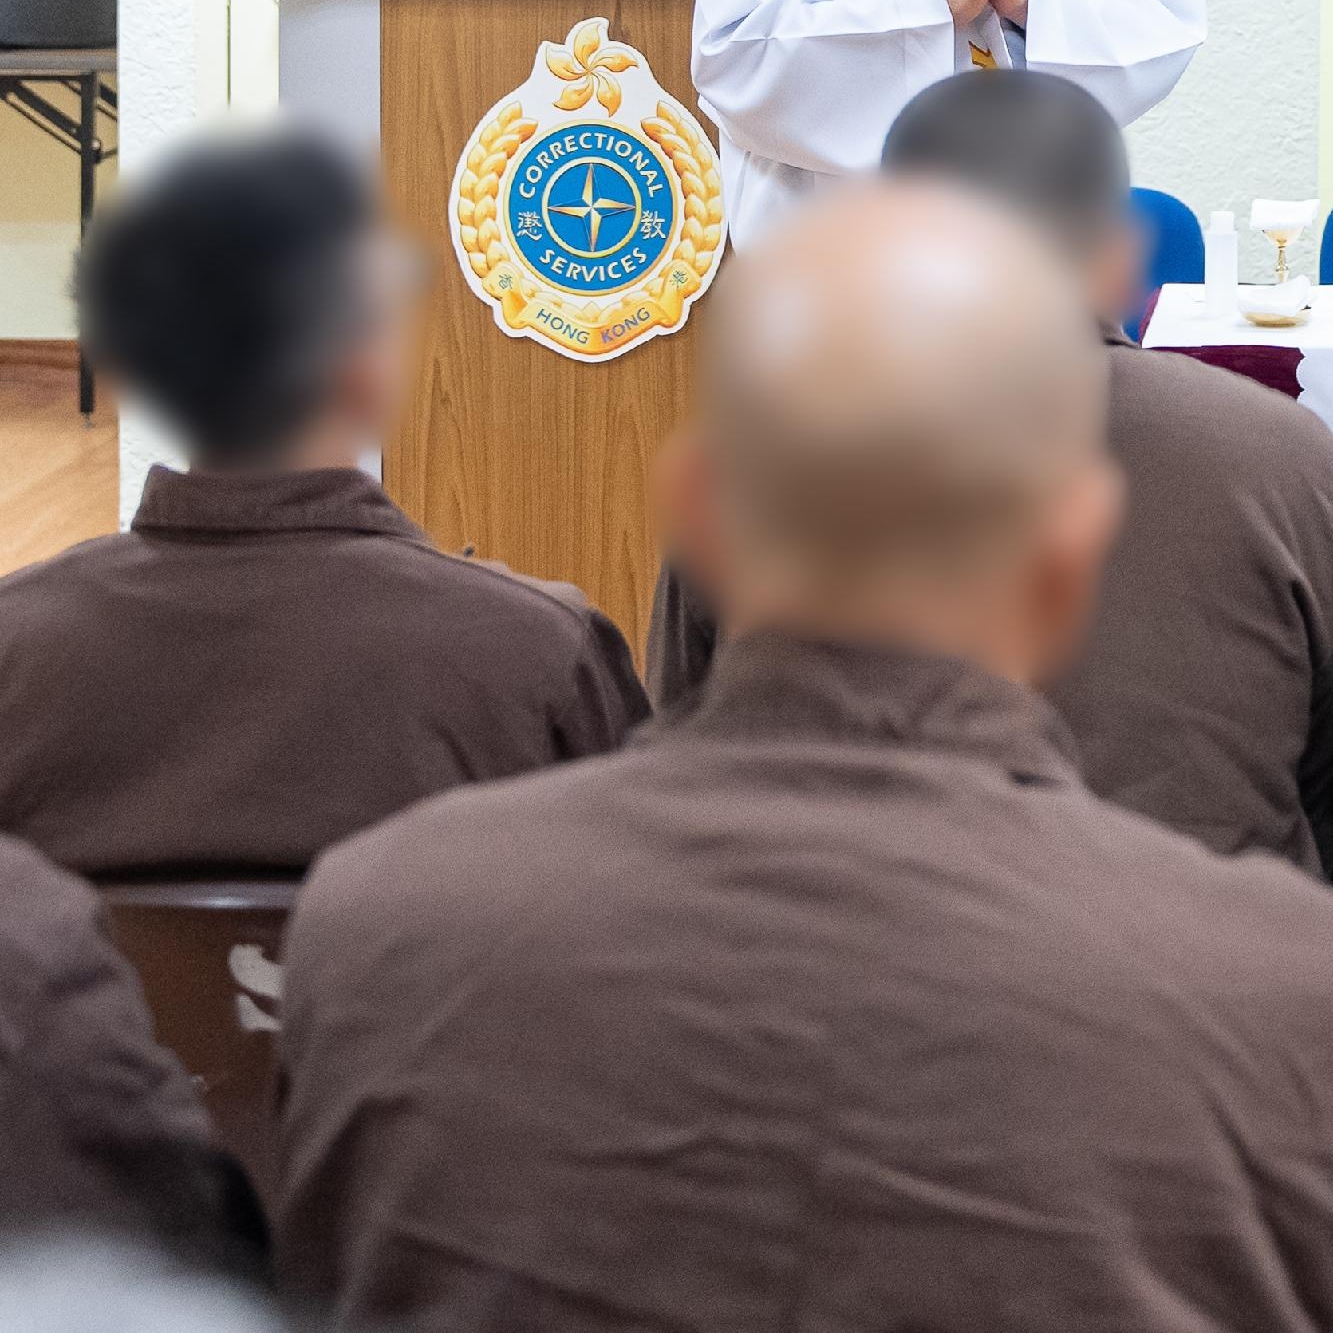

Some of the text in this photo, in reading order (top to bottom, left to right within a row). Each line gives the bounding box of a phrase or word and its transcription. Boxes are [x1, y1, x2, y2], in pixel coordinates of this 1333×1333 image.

[519, 132, 665, 198] CORRECTIONAL
[539, 247, 647, 283] SERVICES
[536, 307, 651, 345] HONG KONG
